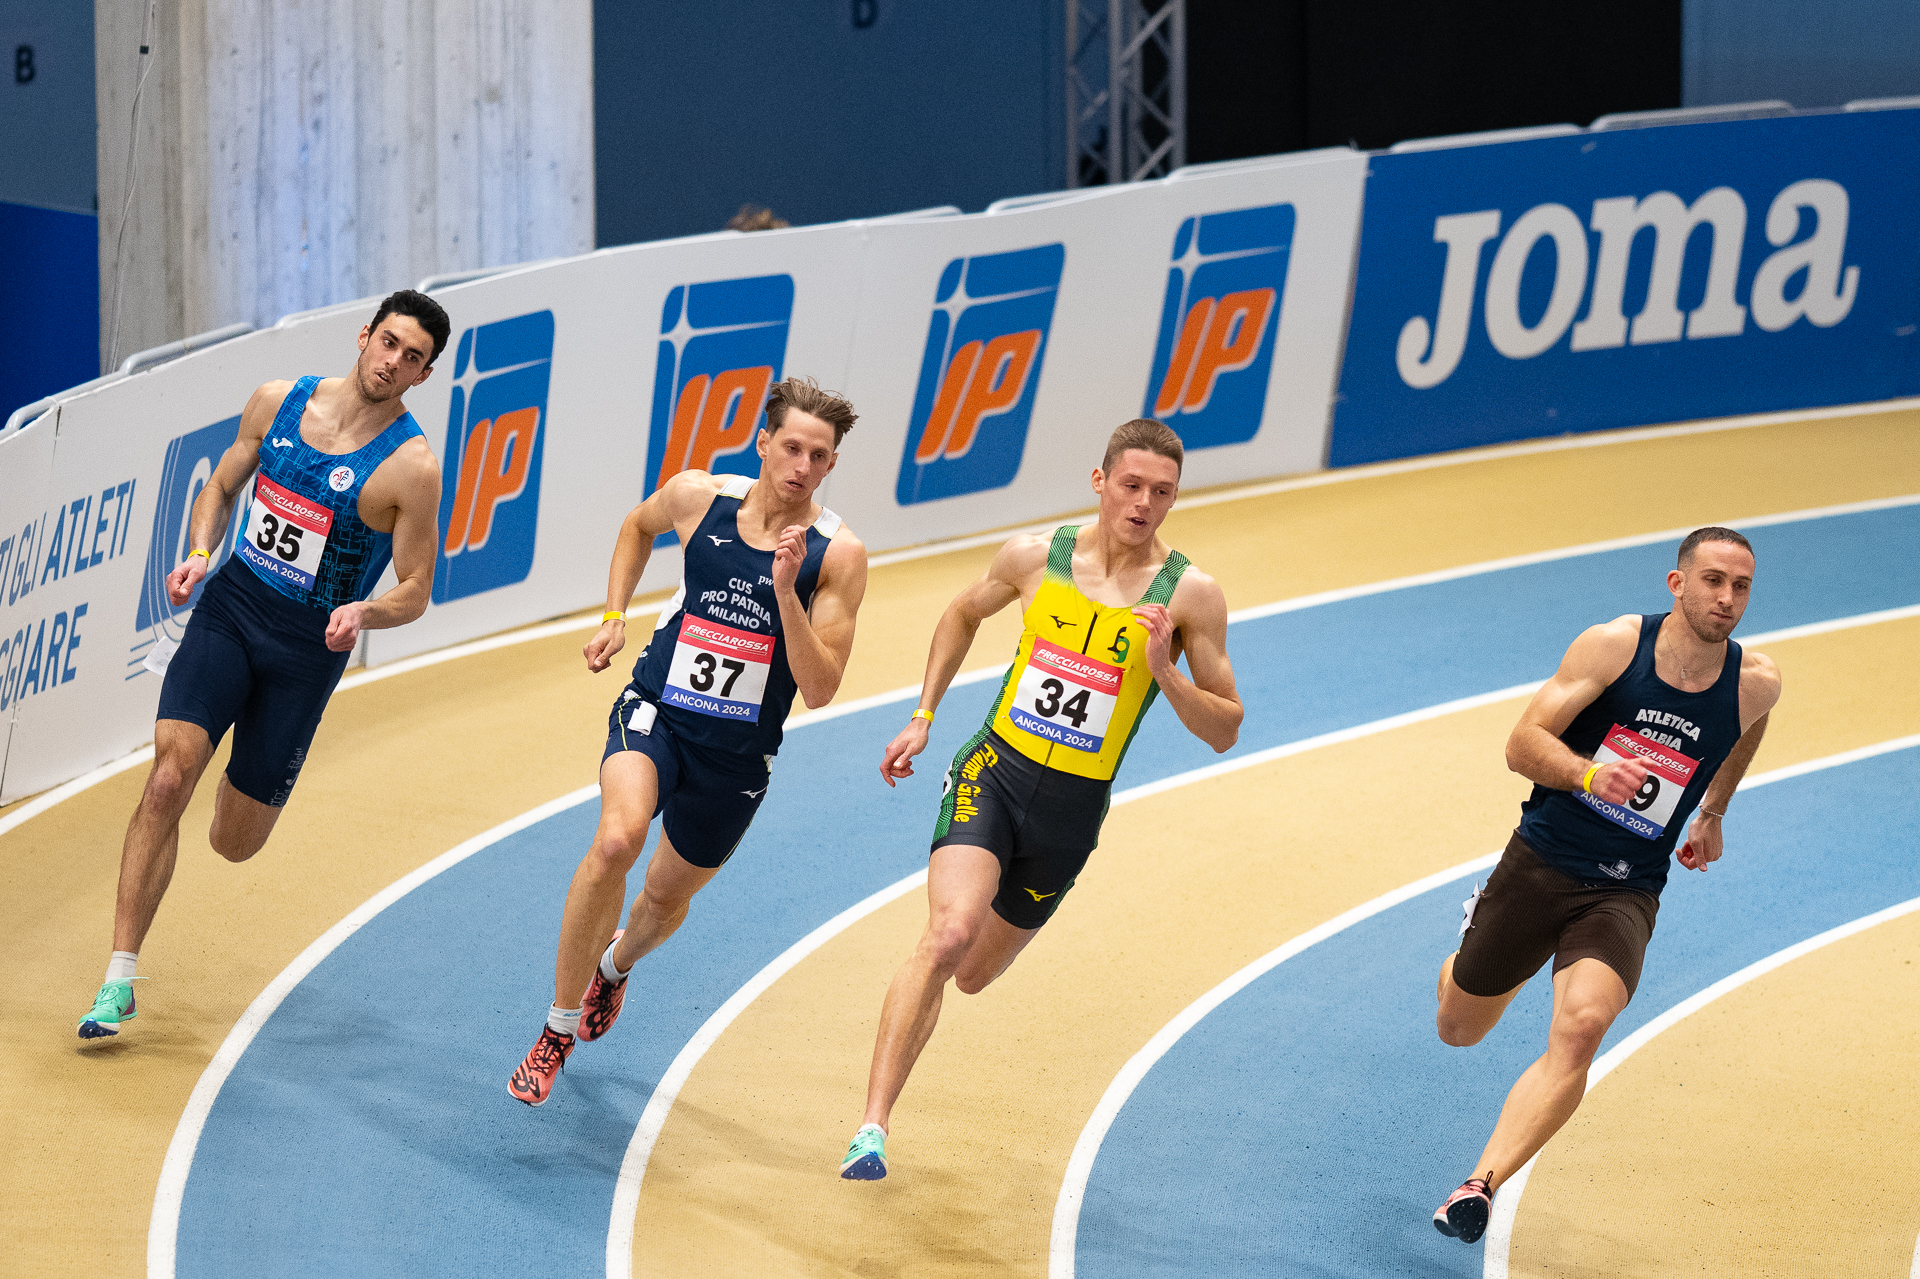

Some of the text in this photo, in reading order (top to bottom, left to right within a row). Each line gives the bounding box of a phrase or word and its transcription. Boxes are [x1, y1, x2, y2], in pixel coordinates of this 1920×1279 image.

[16, 44, 35, 83] B
[261, 484, 328, 524] FRECCIAROSSA
[9, 510, 47, 607] GLI
[40, 478, 136, 587] ATLETI
[256, 513, 304, 562] 35
[242, 546, 306, 585] ANCONA 2024
[758, 575, 774, 586] pw
[728, 577, 753, 595] CUS
[700, 590, 771, 626] PRO PATRIA
[707, 604, 760, 630] MILANO
[687, 624, 769, 652] FRECCIAROSSA
[690, 652, 746, 698] 37
[1037, 648, 1119, 684] FRECCIAROSSA
[671, 692, 750, 716] ANCONA 2024
[1035, 678, 1091, 729] 34
[1015, 715, 1093, 749] ANCONA 2024
[1635, 708, 1701, 741] ATLETICA
[1639, 727, 1682, 751] OLBIA
[1614, 733, 1691, 775] FRECCIAROSSA
[1629, 774, 1661, 811] 9
[1580, 791, 1654, 836] ANCONA 2024
